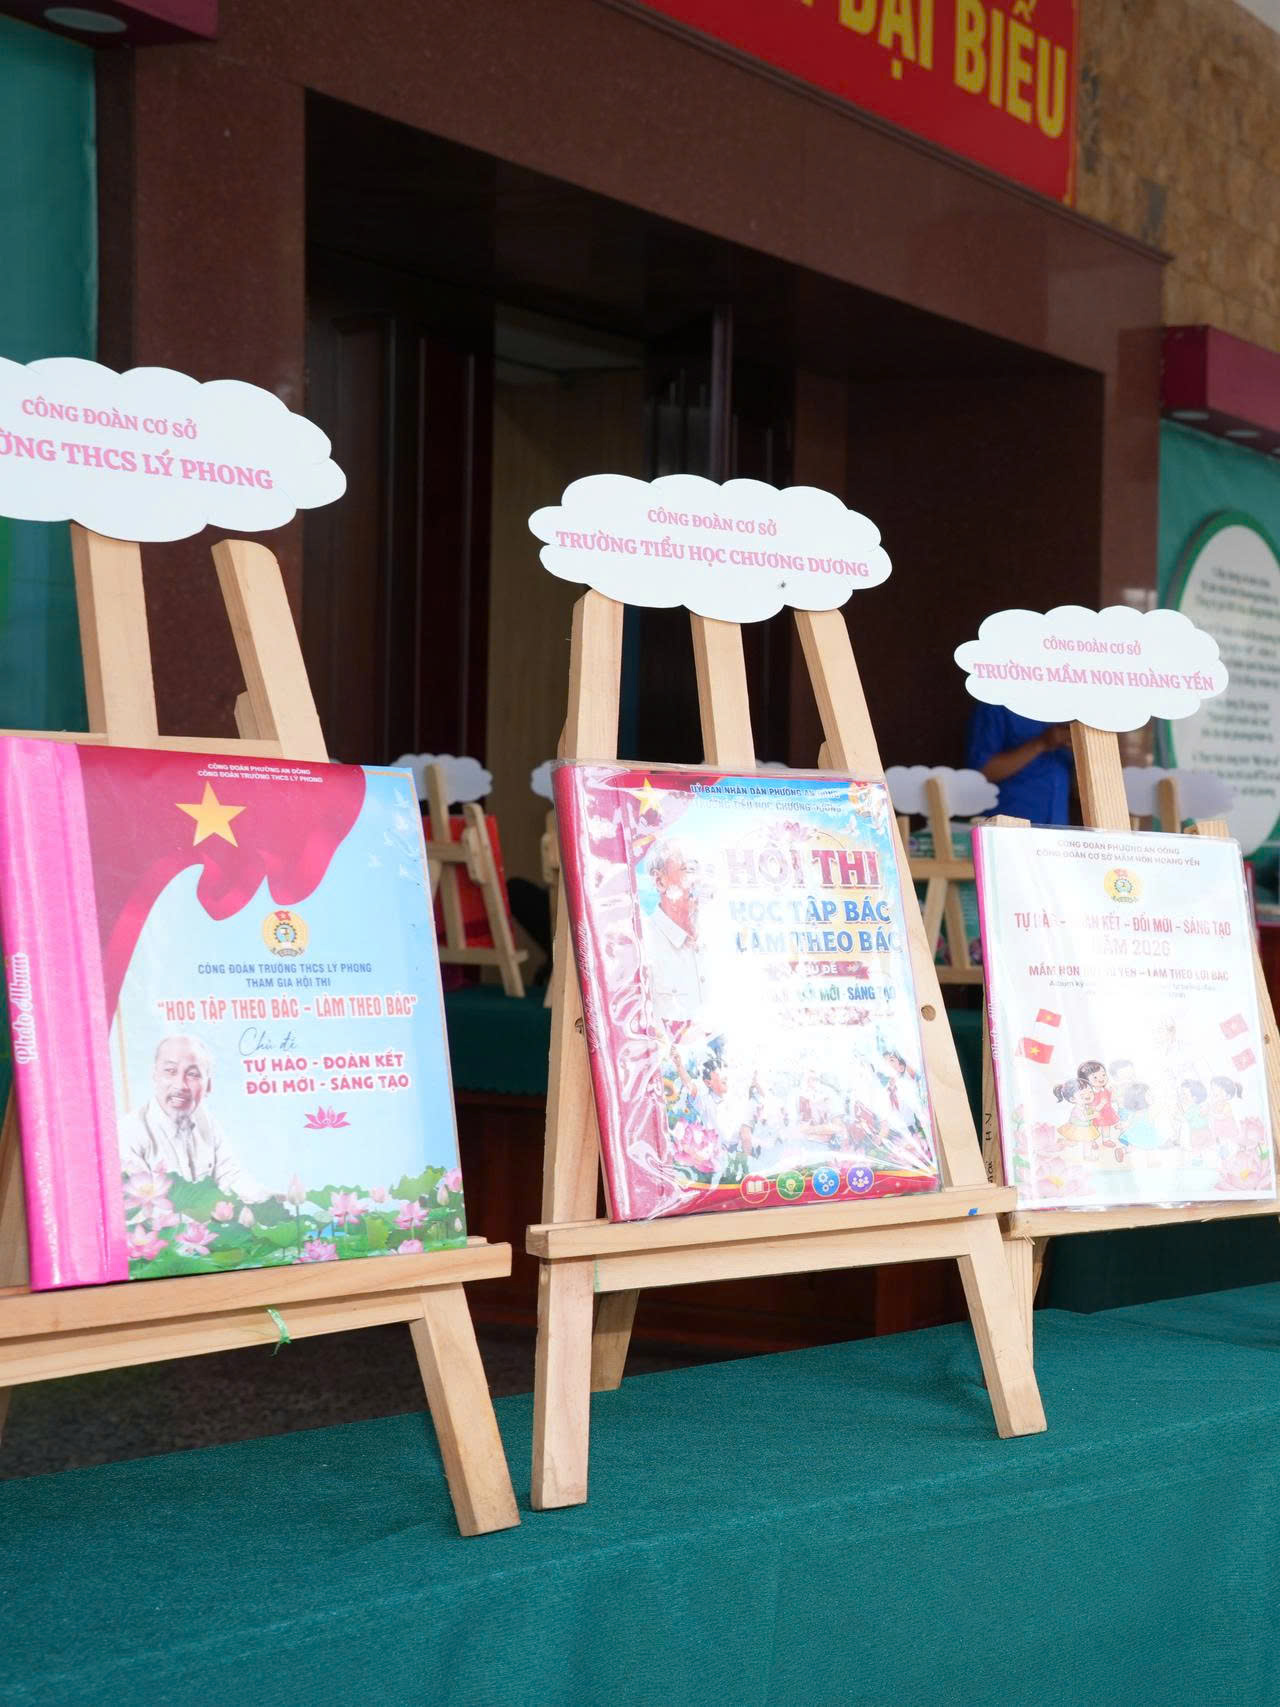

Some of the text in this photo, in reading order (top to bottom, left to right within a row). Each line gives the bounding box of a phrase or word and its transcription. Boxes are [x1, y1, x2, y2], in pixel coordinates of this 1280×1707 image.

[954, 0, 1067, 139] BIỂU
[22, 396, 198, 440] CÔNG ĐOÀN CƠ SỞ
[0, 428, 274, 490] ỜNG THCS LÝ PHONG
[647, 506, 778, 537] CÔNG ĐOÀN CƠ SỞ
[555, 529, 870, 578] TRƯỜNG TIỂU HỌC CHƯƠNG DƯƠNG
[1043, 635, 1142, 656] CÔNG ĐOÀN CƠ SỞ
[973, 659, 1215, 692] TRƯỜNG MẦM NON HOÀNG YẾN
[705, 786, 722, 794] BAN
[726, 842, 881, 893] HỘI THI
[788, 894, 838, 926] TẬP
[842, 894, 893, 924] BÁC
[788, 929, 854, 954] THEO
[858, 925, 904, 954] BÁC
[1014, 912, 1031, 933] TỰ
[1153, 915, 1173, 933] MỚI
[1183, 914, 1210, 936] SÁNG
[1213, 919, 1231, 940] TẠO
[198, 960, 372, 975] CÔNG ĐOÀN TRƯỜNG THCS LÝ PHONG
[246, 976, 331, 990] THAM GIA HỘI THI
[847, 981, 875, 1002] SÁNG
[200, 996, 227, 1025] TẬP
[232, 1000, 267, 1020] THEO
[271, 994, 300, 1019] BÁC
[316, 994, 345, 1018] LÀM
[349, 997, 382, 1017] THEO
[243, 1049, 403, 1076] TỰ HÀO ĐOÀN KẾT
[246, 1074, 409, 1095] ĐỔI MỚI SÁNG TẠO
